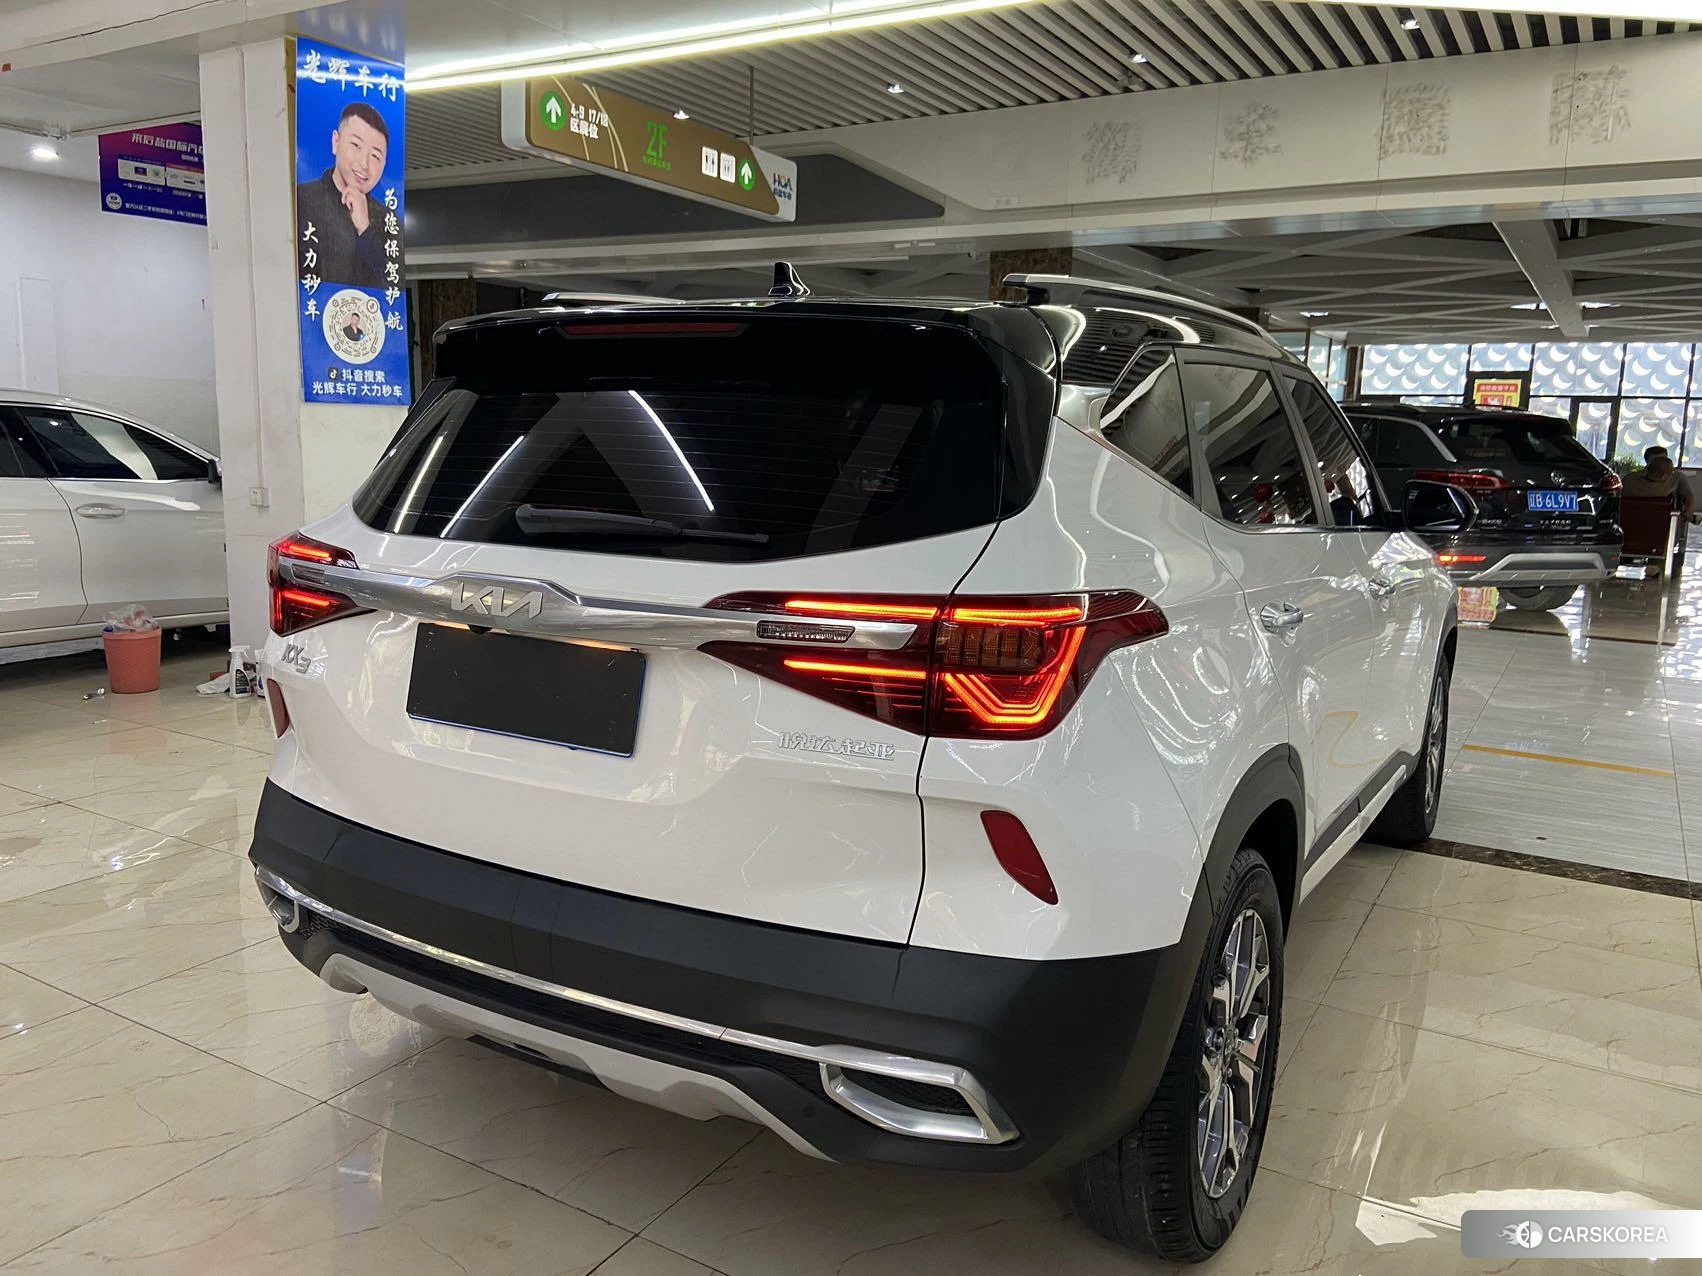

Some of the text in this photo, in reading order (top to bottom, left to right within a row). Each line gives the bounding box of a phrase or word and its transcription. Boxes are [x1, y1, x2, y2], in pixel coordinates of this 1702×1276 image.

[304, 49, 400, 102] 光辉车行
[647, 120, 668, 160] 2F
[302, 221, 321, 321] 大力秒车
[384, 188, 403, 331] 为您保驾护航
[312, 381, 403, 397] 光辉车行 大力秒车
[342, 368, 385, 383] 抖音搜索
